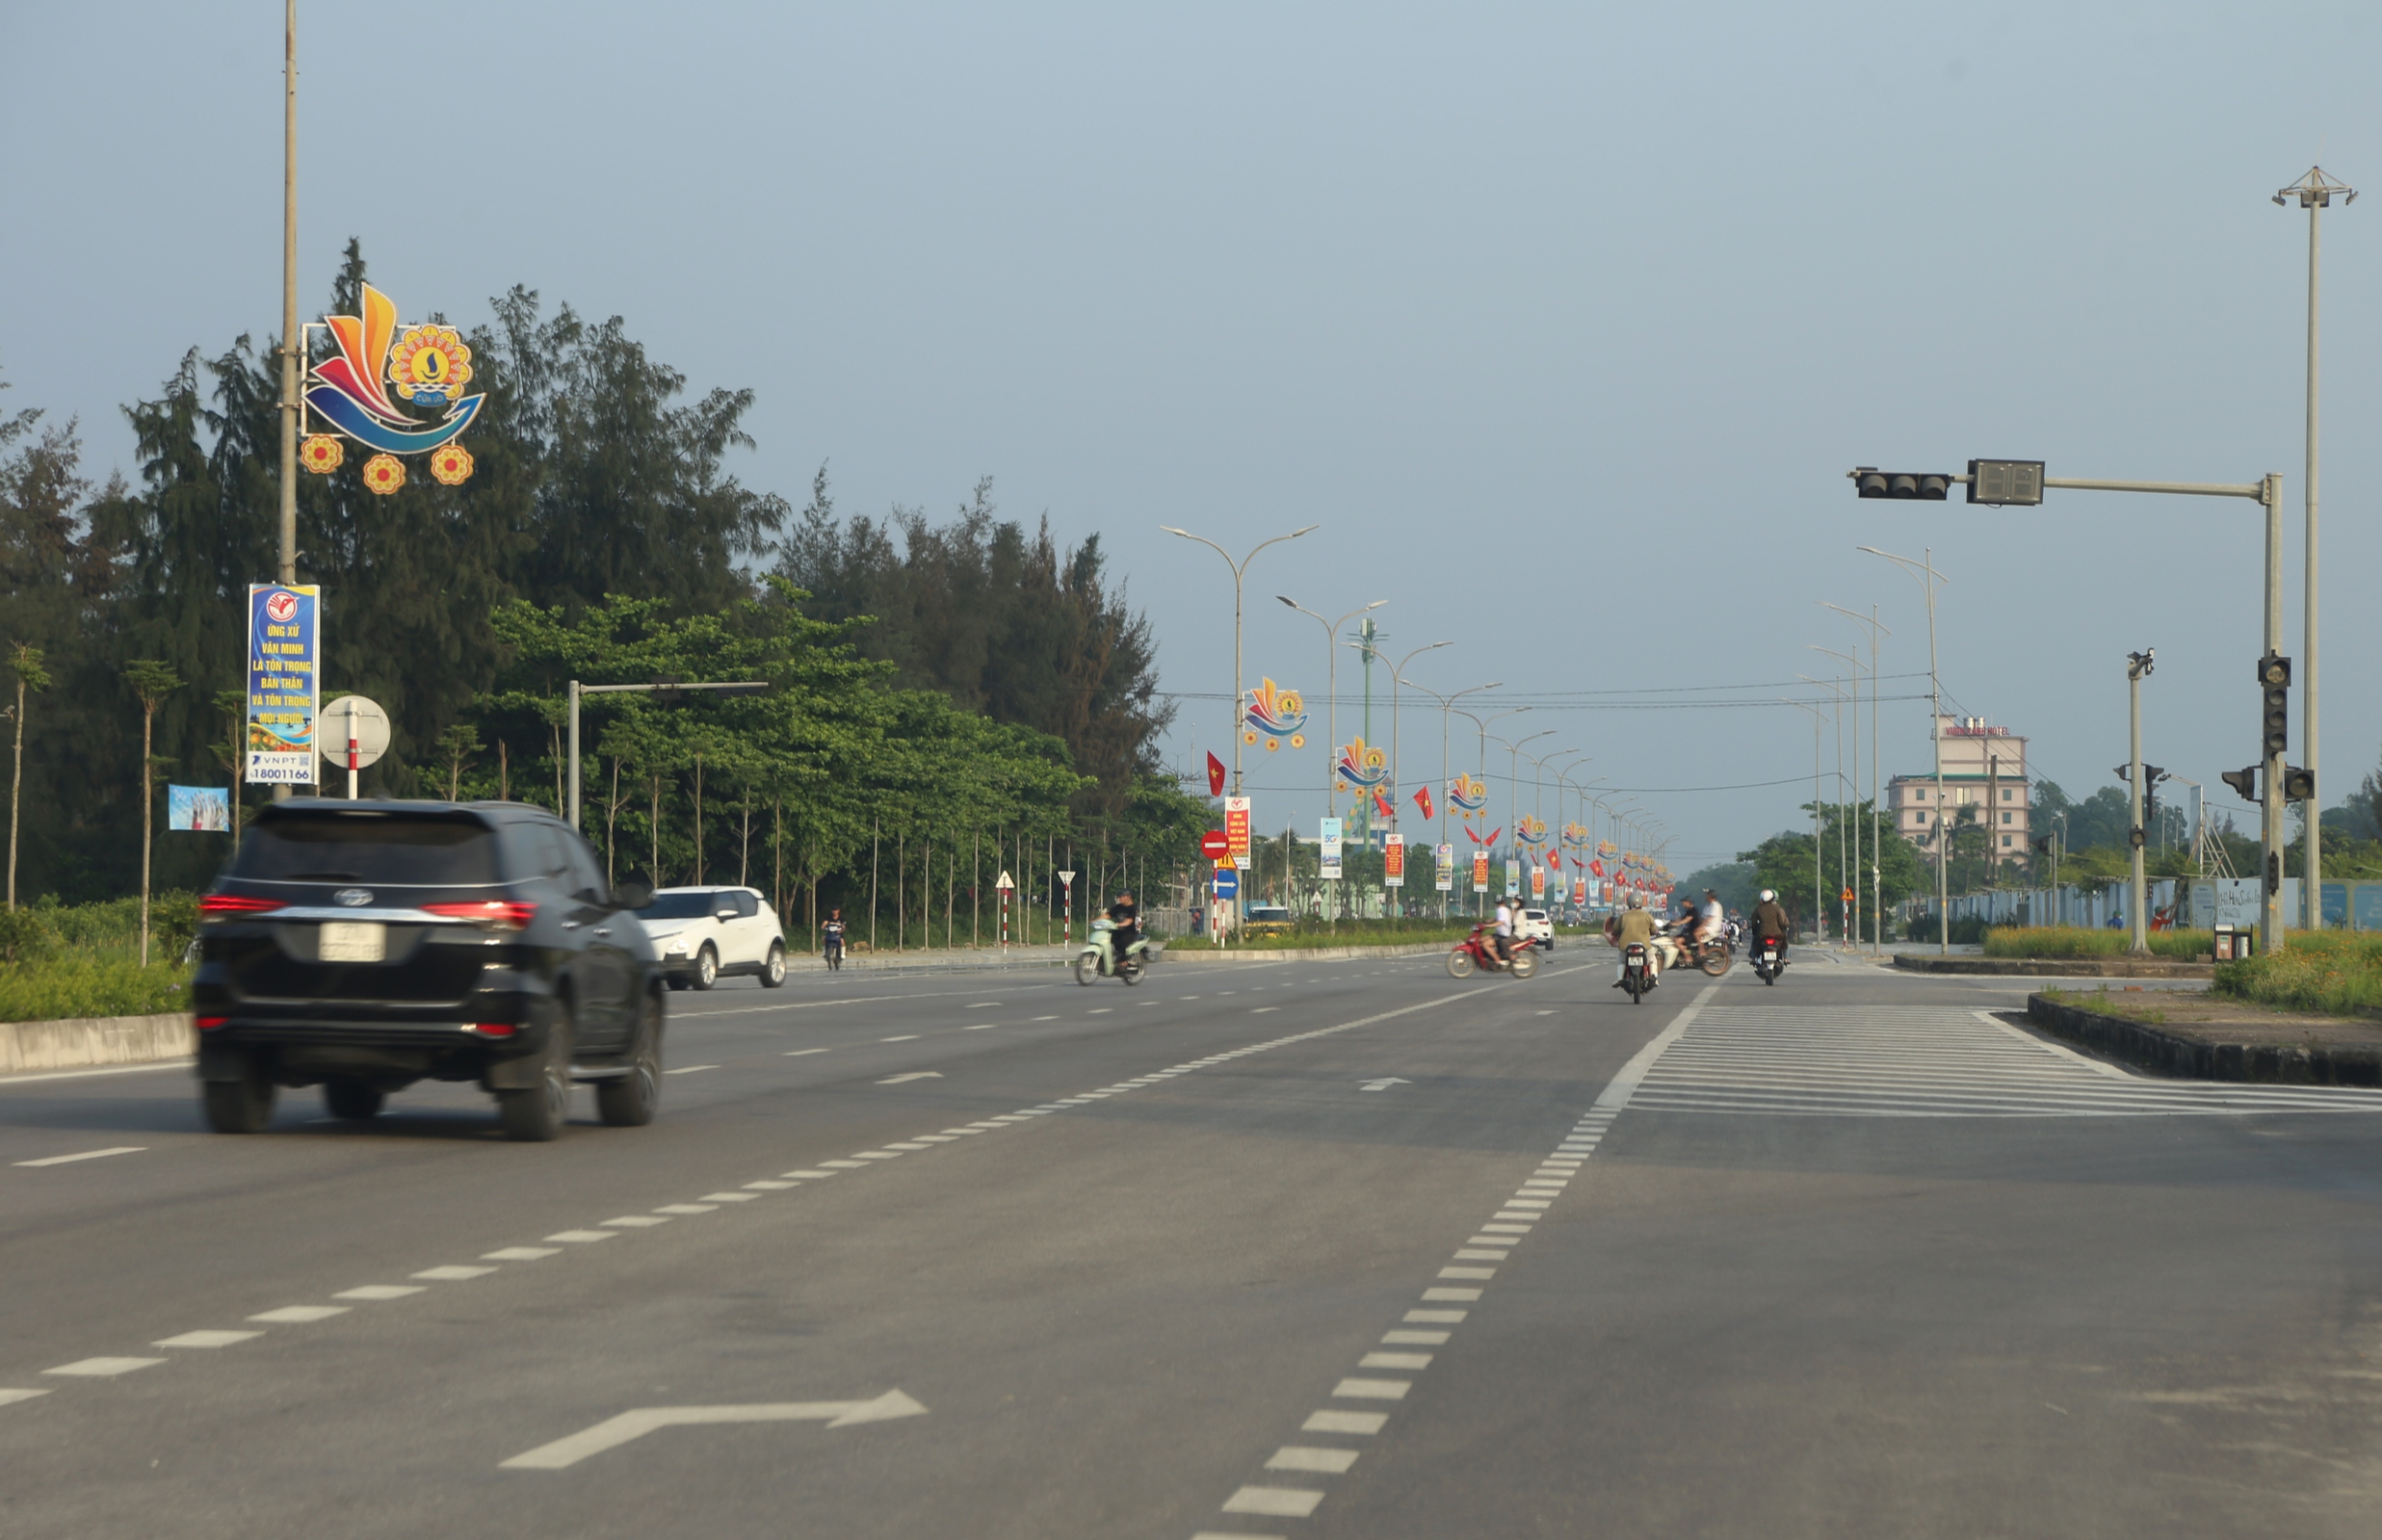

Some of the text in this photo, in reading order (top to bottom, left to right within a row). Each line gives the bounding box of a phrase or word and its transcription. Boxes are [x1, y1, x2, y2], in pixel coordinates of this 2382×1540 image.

[268, 622, 301, 637] ỨNG XỬ
[262, 640, 303, 654] VĂN MINH
[253, 658, 312, 674] LÀ TÔN TRỌNG
[261, 674, 303, 690] BẢN THÂN
[252, 692, 311, 709] VÀ TÔN TRỌNG
[254, 769, 309, 779] 18001166
